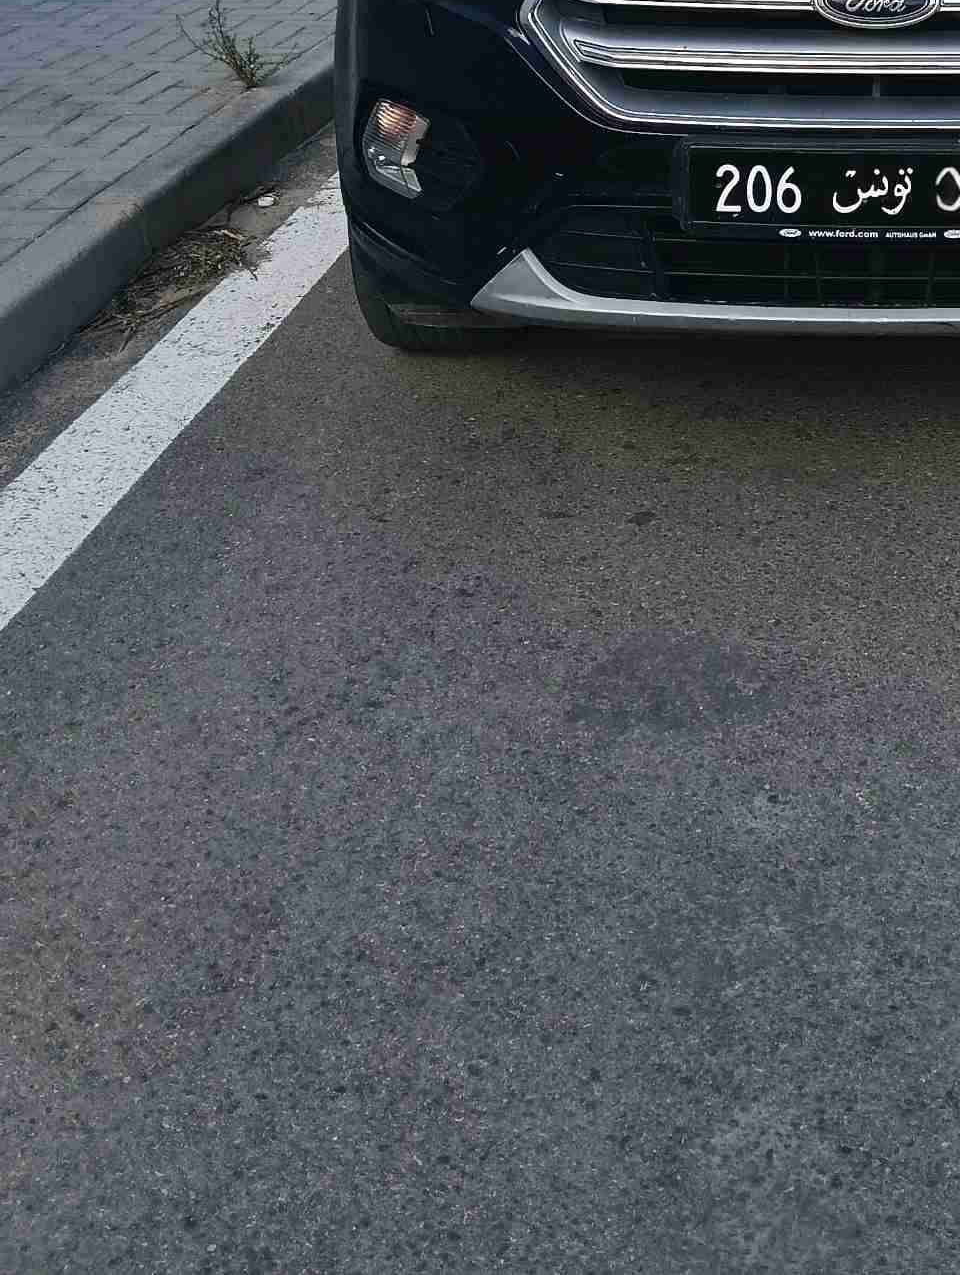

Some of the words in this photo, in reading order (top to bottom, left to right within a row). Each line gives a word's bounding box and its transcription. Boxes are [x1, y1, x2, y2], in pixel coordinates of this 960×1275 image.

[716, 164, 802, 214] 206
[832, 167, 914, 216] تونس
[808, 229, 879, 238] www.ford.com
